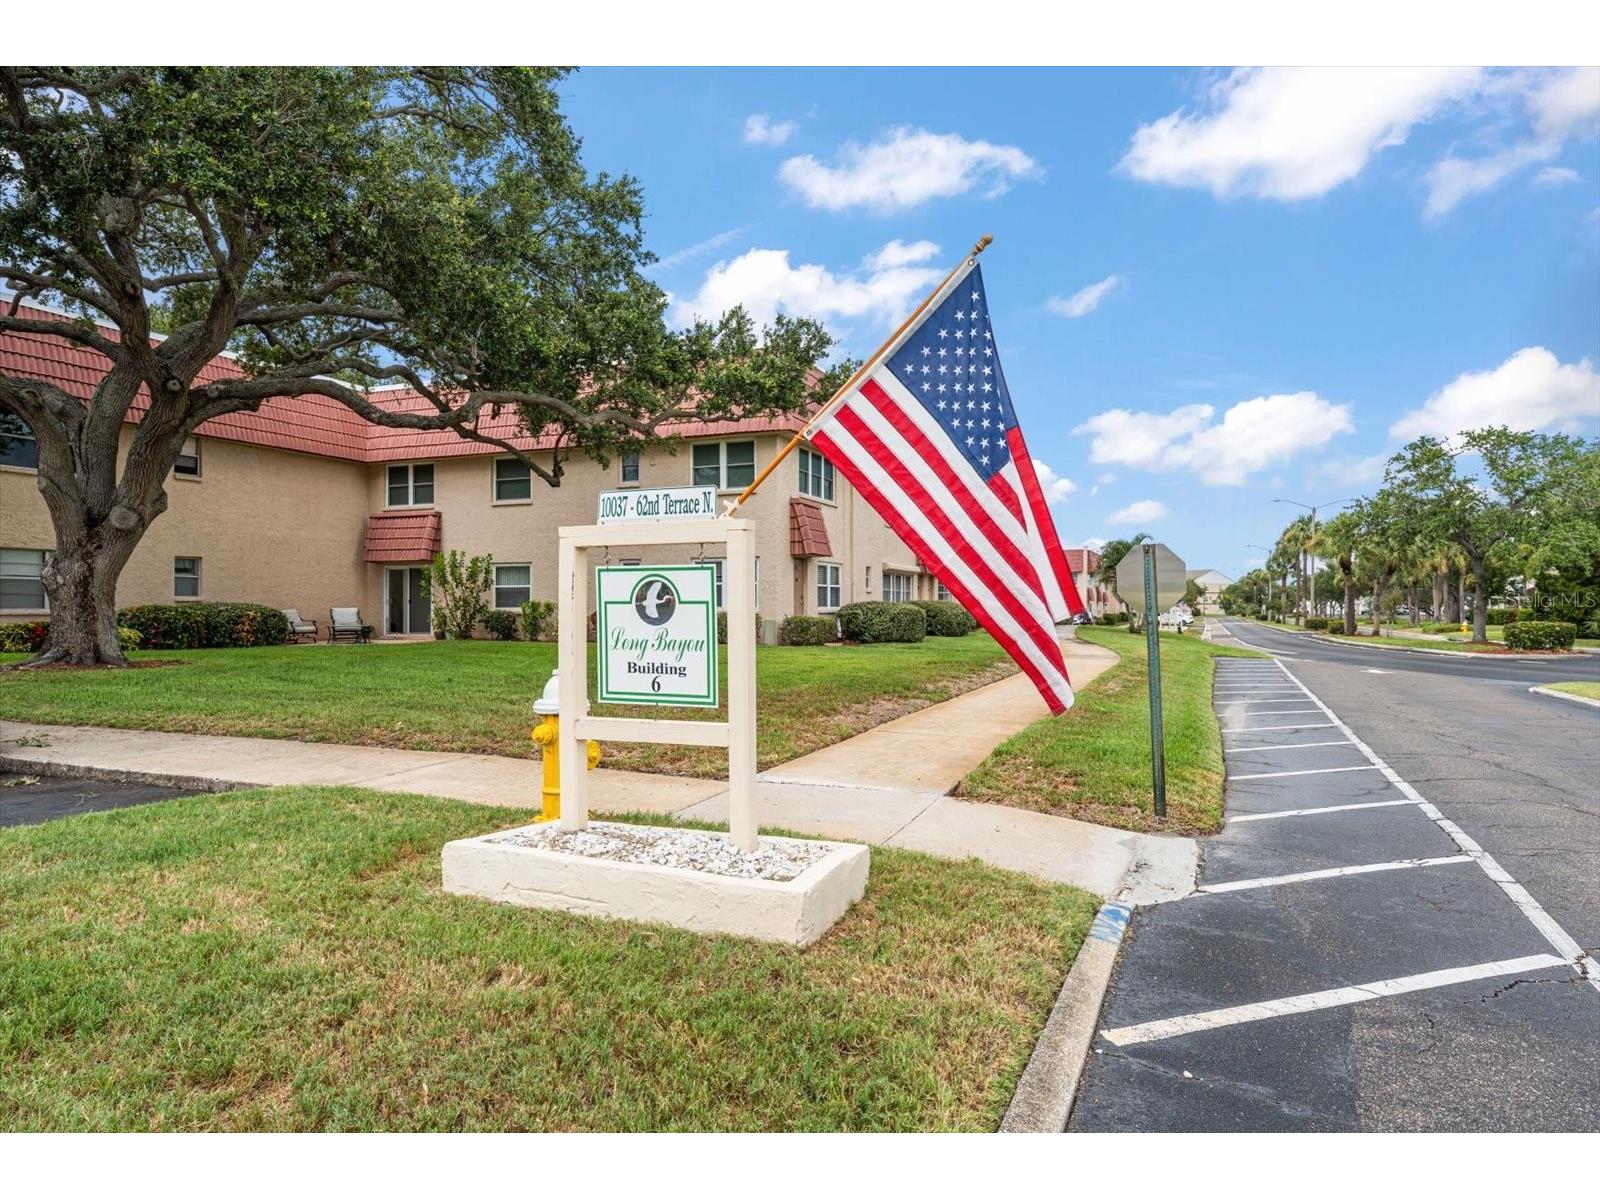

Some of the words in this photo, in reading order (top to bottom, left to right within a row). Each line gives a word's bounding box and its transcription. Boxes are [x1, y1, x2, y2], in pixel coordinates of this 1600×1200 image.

[601, 496, 628, 517] 10037
[637, 494, 659, 516] 62nd
[662, 493, 700, 515] Terrace
[702, 491, 714, 514] N.
[609, 626, 648, 661] Long
[651, 627, 705, 662] Bayou
[627, 661, 687, 678] Building
[651, 675, 661, 692] 6
